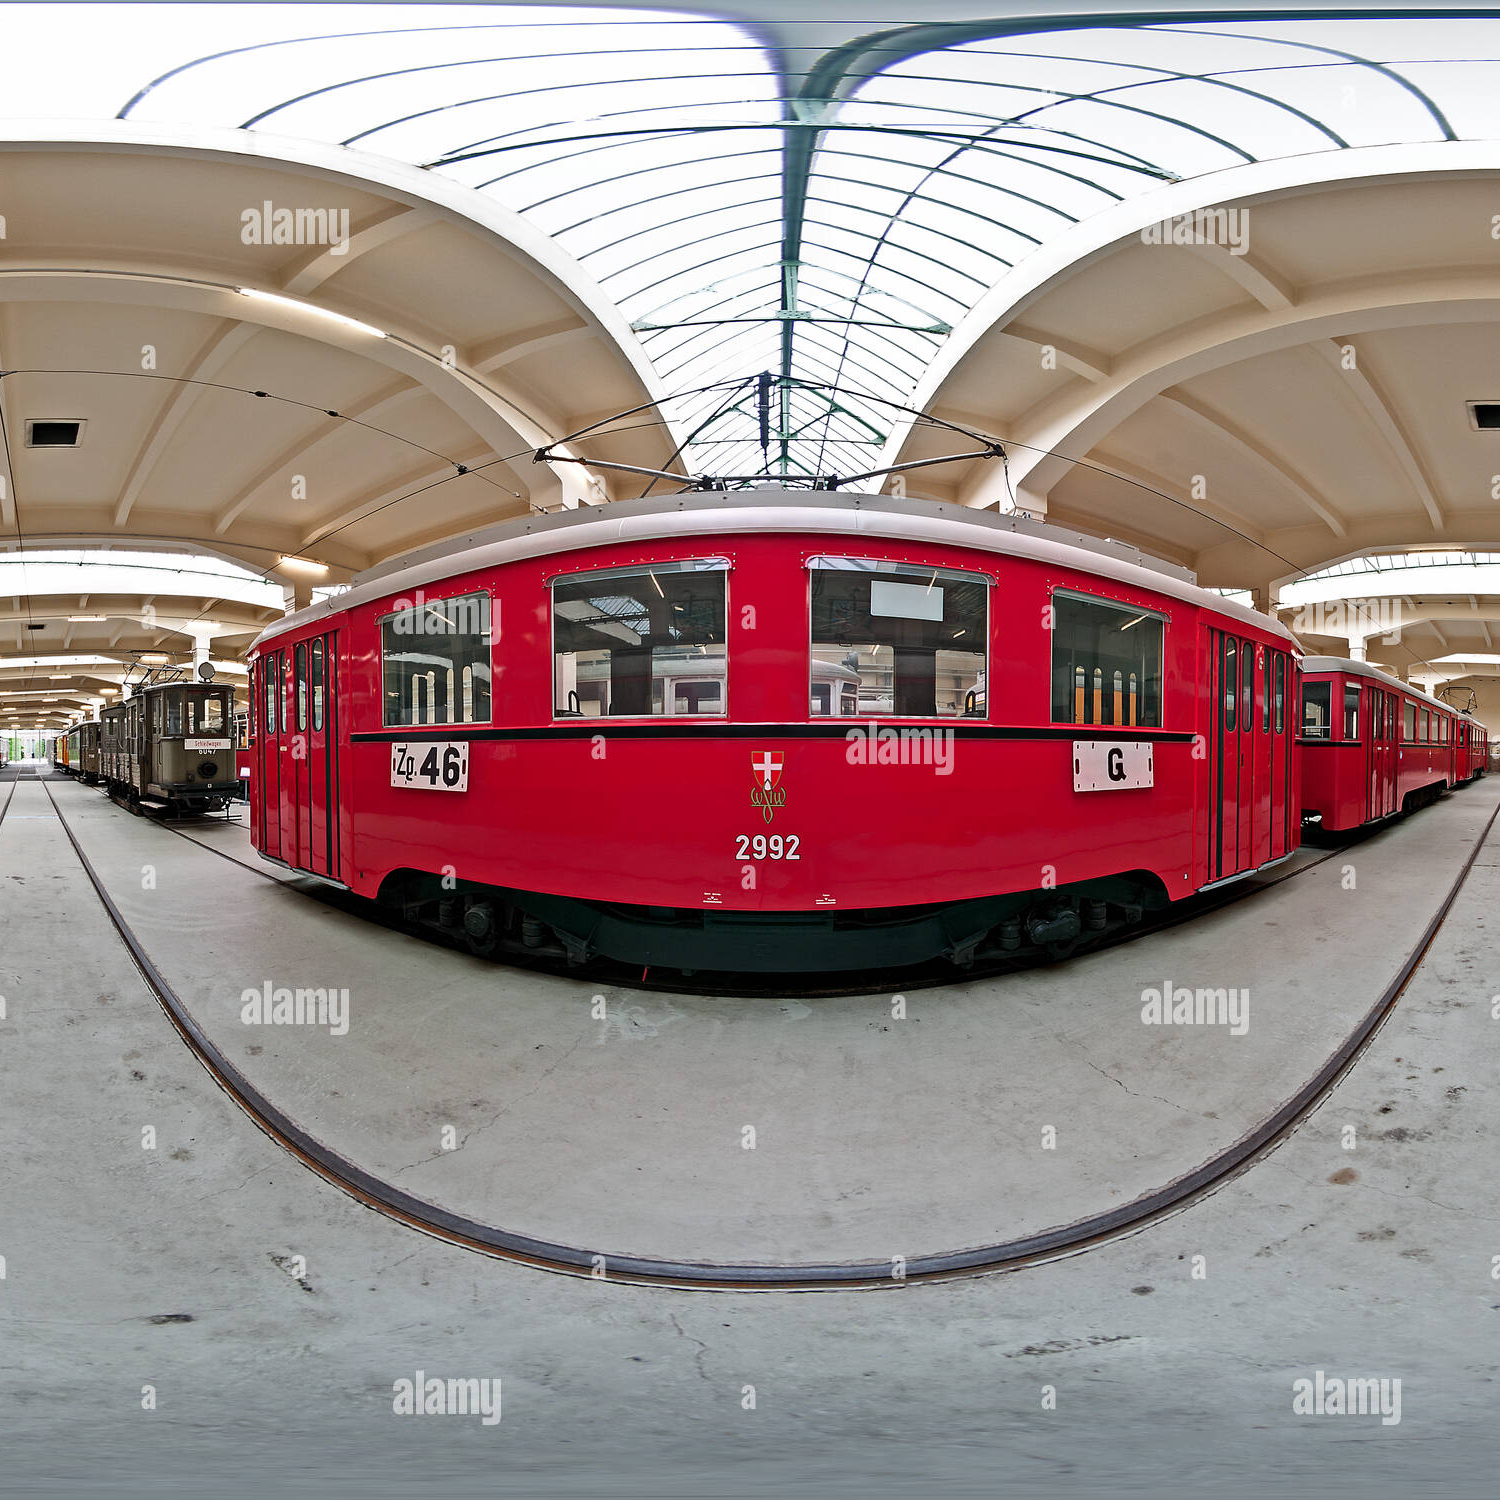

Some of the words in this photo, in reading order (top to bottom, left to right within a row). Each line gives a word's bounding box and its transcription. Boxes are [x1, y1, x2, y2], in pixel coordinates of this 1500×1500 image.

[419, 746, 461, 787] 46
[1107, 747, 1127, 782] G
[735, 834, 801, 860] 2992
